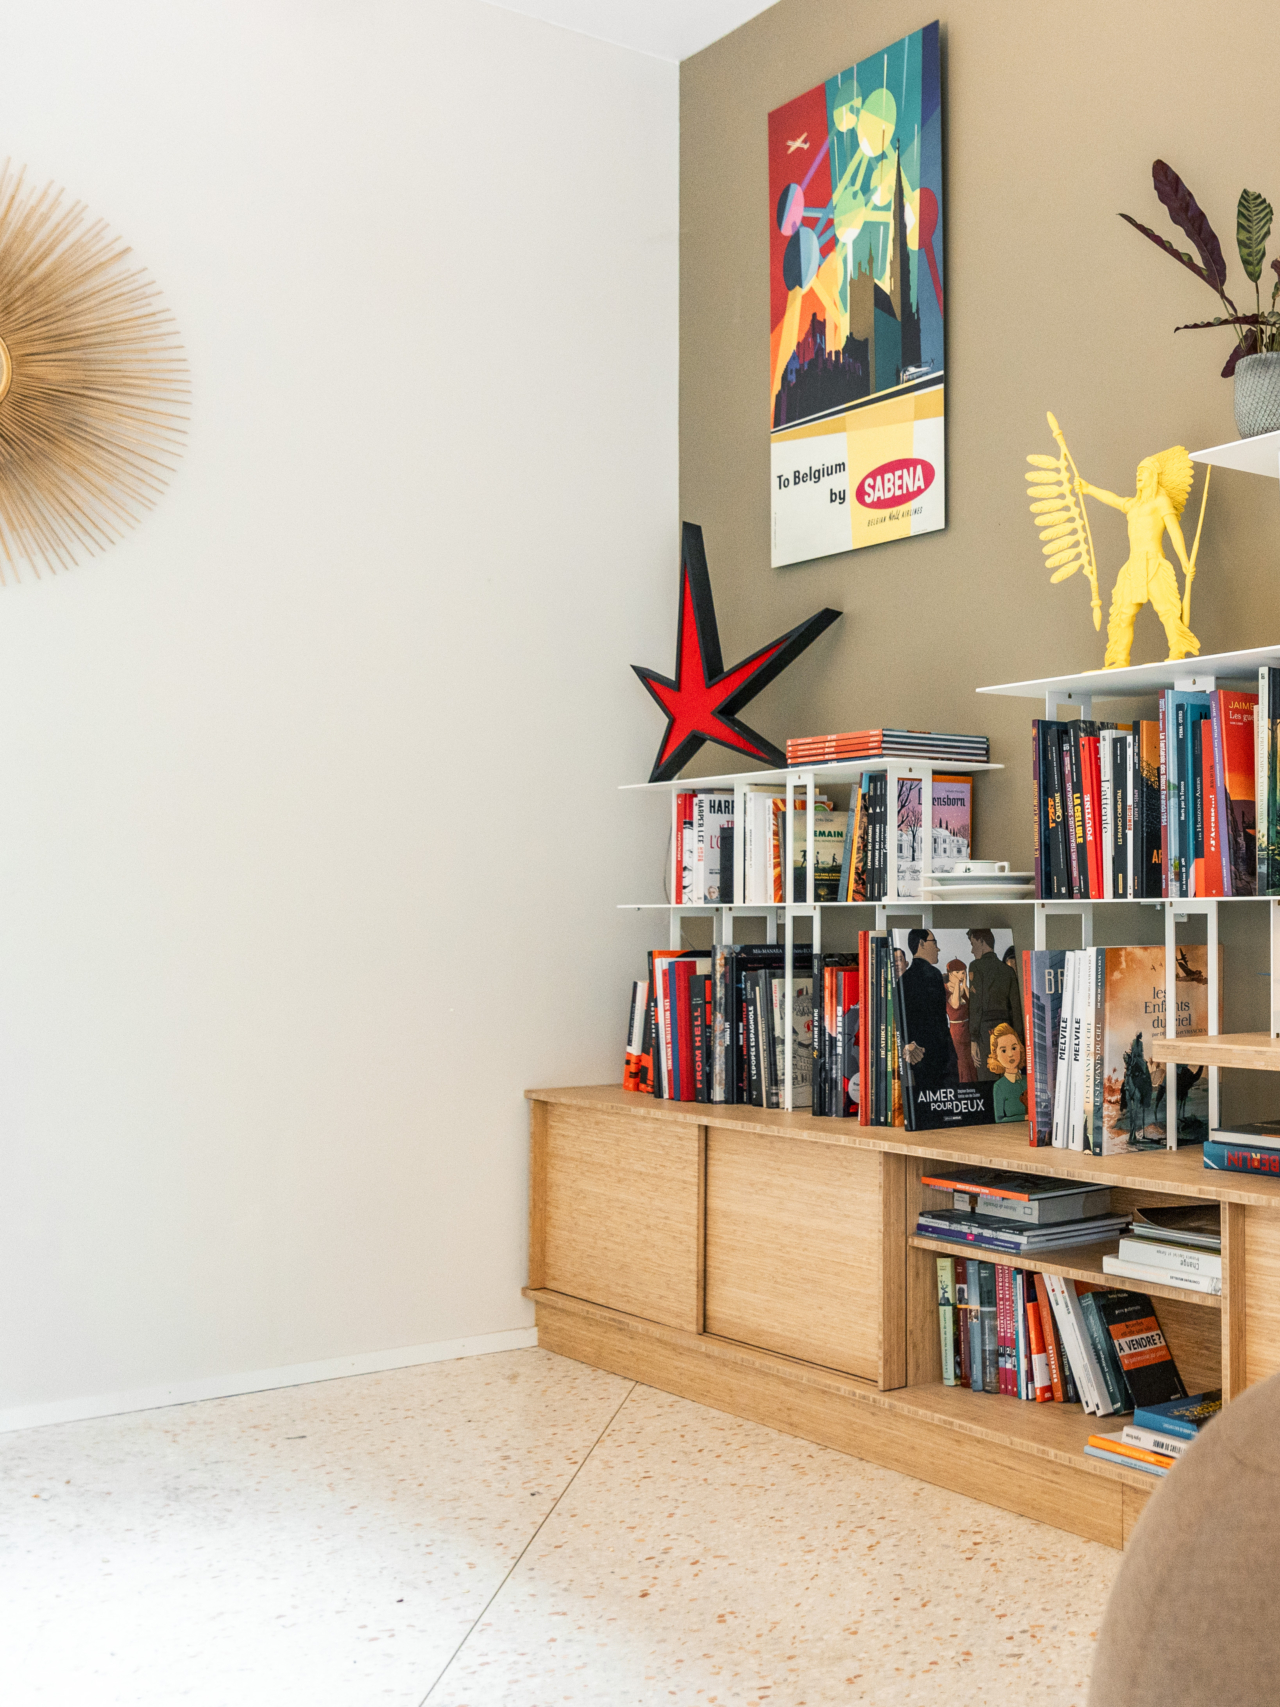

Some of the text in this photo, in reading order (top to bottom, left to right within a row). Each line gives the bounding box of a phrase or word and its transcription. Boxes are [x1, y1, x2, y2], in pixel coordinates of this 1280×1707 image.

[776, 461, 846, 490] To Belgium
[863, 464, 925, 504] SABENA
[829, 488, 847, 505] by
[901, 506, 923, 519] AIRLINES
[1228, 700, 1255, 711] JAIME
[1229, 710, 1243, 721] Les
[918, 786, 966, 807] Lensborn
[1073, 793, 1082, 806] LA
[1074, 805, 1084, 844] CELLULE
[1084, 793, 1093, 841] POUTINE
[814, 830, 844, 838] EMAIN
[1069, 815, 1077, 852] TIRAILLEURS
[1144, 1000, 1190, 1014] Enfnts
[664, 1011, 672, 1044] MEILLEURS
[748, 1005, 756, 1047] ESPAGNOLE
[1152, 1015, 1167, 1029] du
[693, 1007, 703, 1089] FROM HELL
[1058, 1016, 1068, 1061] MELVILE
[1073, 1017, 1082, 1062] MELVILE
[1085, 1042, 1091, 1054] DU
[1095, 1042, 1102, 1054] DU
[665, 1044, 673, 1071] ENNEMIS
[749, 1046, 757, 1080] L'ÉPOPÉE
[1094, 1053, 1102, 1091] ENFANTS
[917, 1088, 955, 1103] AIMER
[930, 1098, 985, 1114] POUR DEUX
[1227, 1150, 1280, 1173] BERLIN
[1179, 1259, 1200, 1271] Change
[1118, 1338, 1125, 1354] À
[1048, 1345, 1058, 1383] BRUXELLES
